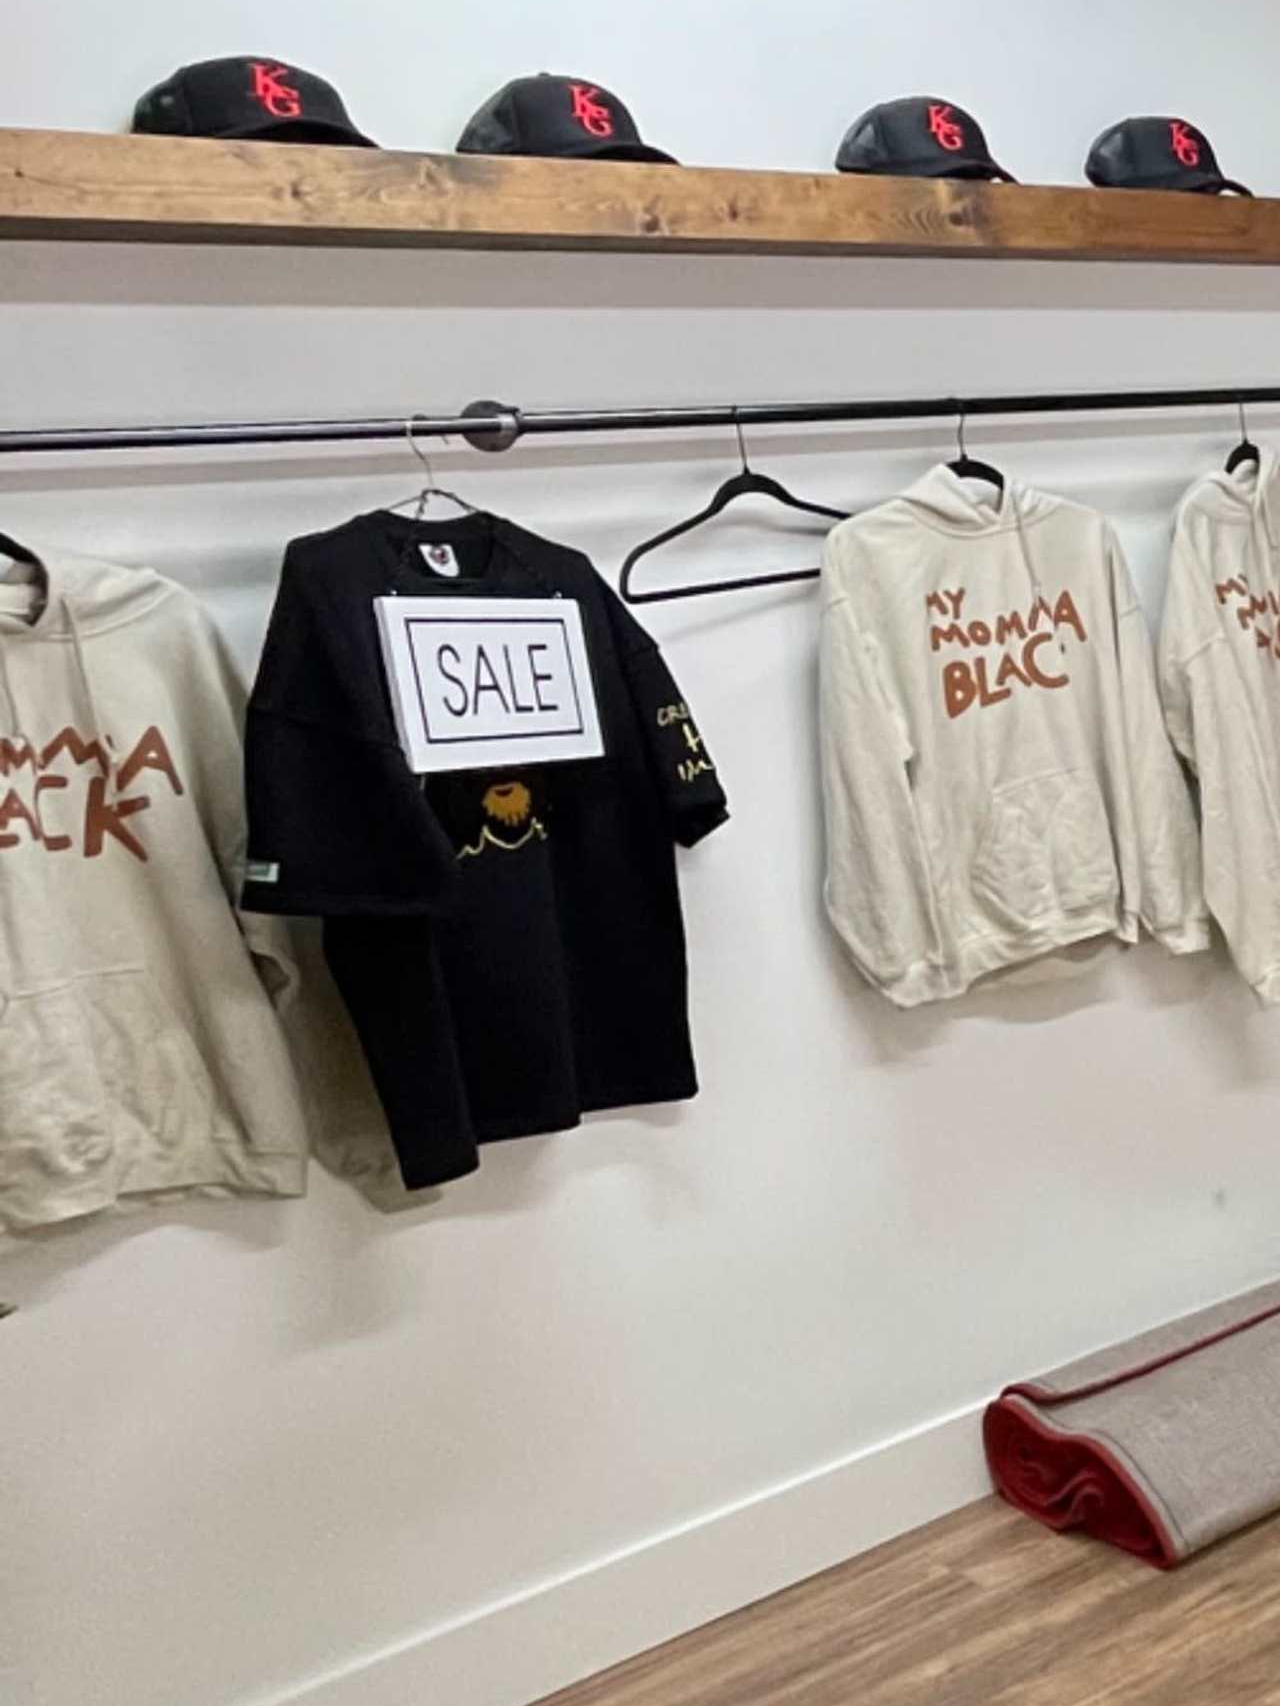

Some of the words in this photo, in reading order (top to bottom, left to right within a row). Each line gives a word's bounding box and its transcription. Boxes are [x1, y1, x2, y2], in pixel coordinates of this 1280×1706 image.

[926, 588, 965, 619] MY
[437, 644, 558, 717] SALE
[0, 775, 150, 863] ACK
